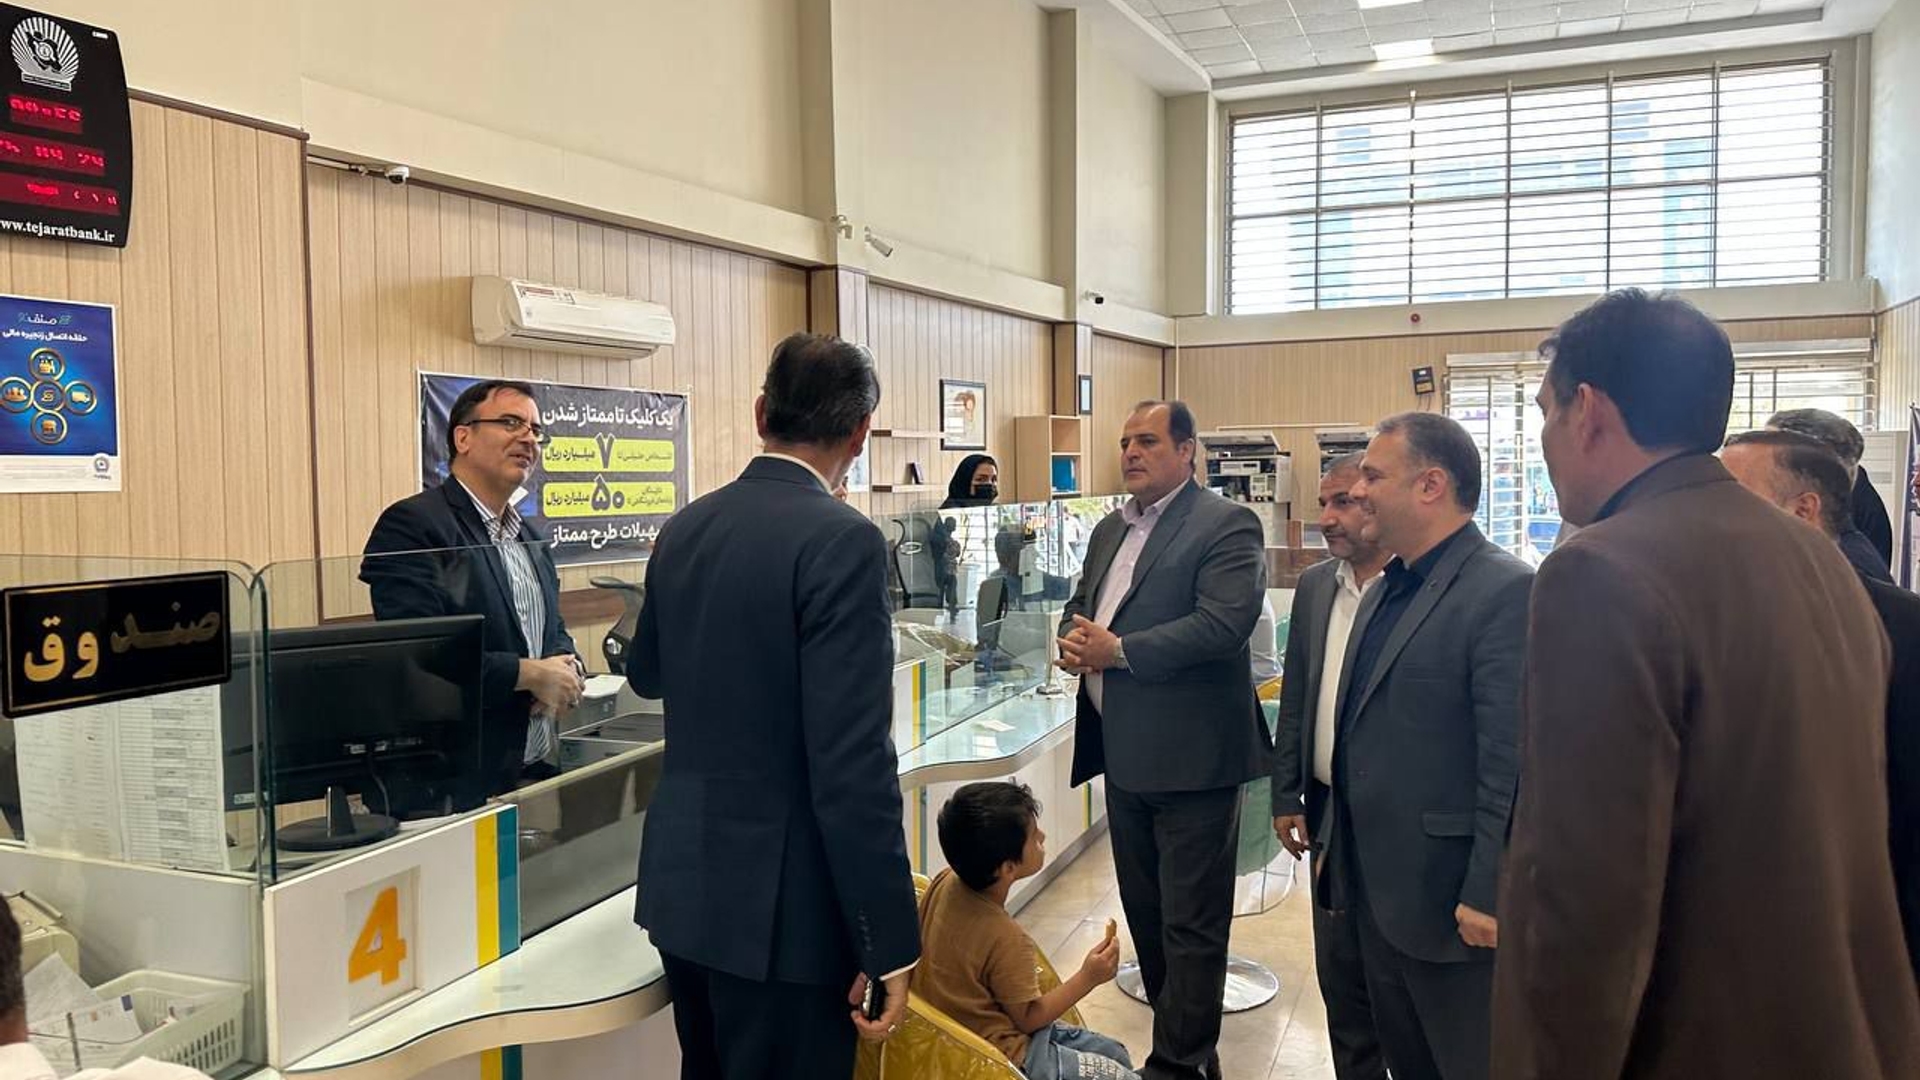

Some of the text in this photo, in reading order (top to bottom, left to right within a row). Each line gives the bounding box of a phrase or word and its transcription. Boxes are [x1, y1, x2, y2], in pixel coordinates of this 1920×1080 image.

[0, 219, 115, 242] ww.tejaratbank.ir
[542, 402, 673, 430] یک کلیک تا ممتاز شدن
[544, 446, 562, 461] ریال
[563, 446, 595, 461] میلیارد
[595, 432, 616, 469] ۷
[546, 491, 562, 506] ریال
[563, 491, 590, 505] میلیارد
[549, 521, 661, 549] هیلات طرح ممتاز
[24, 601, 221, 682] صندوق
[347, 886, 408, 987] 4
